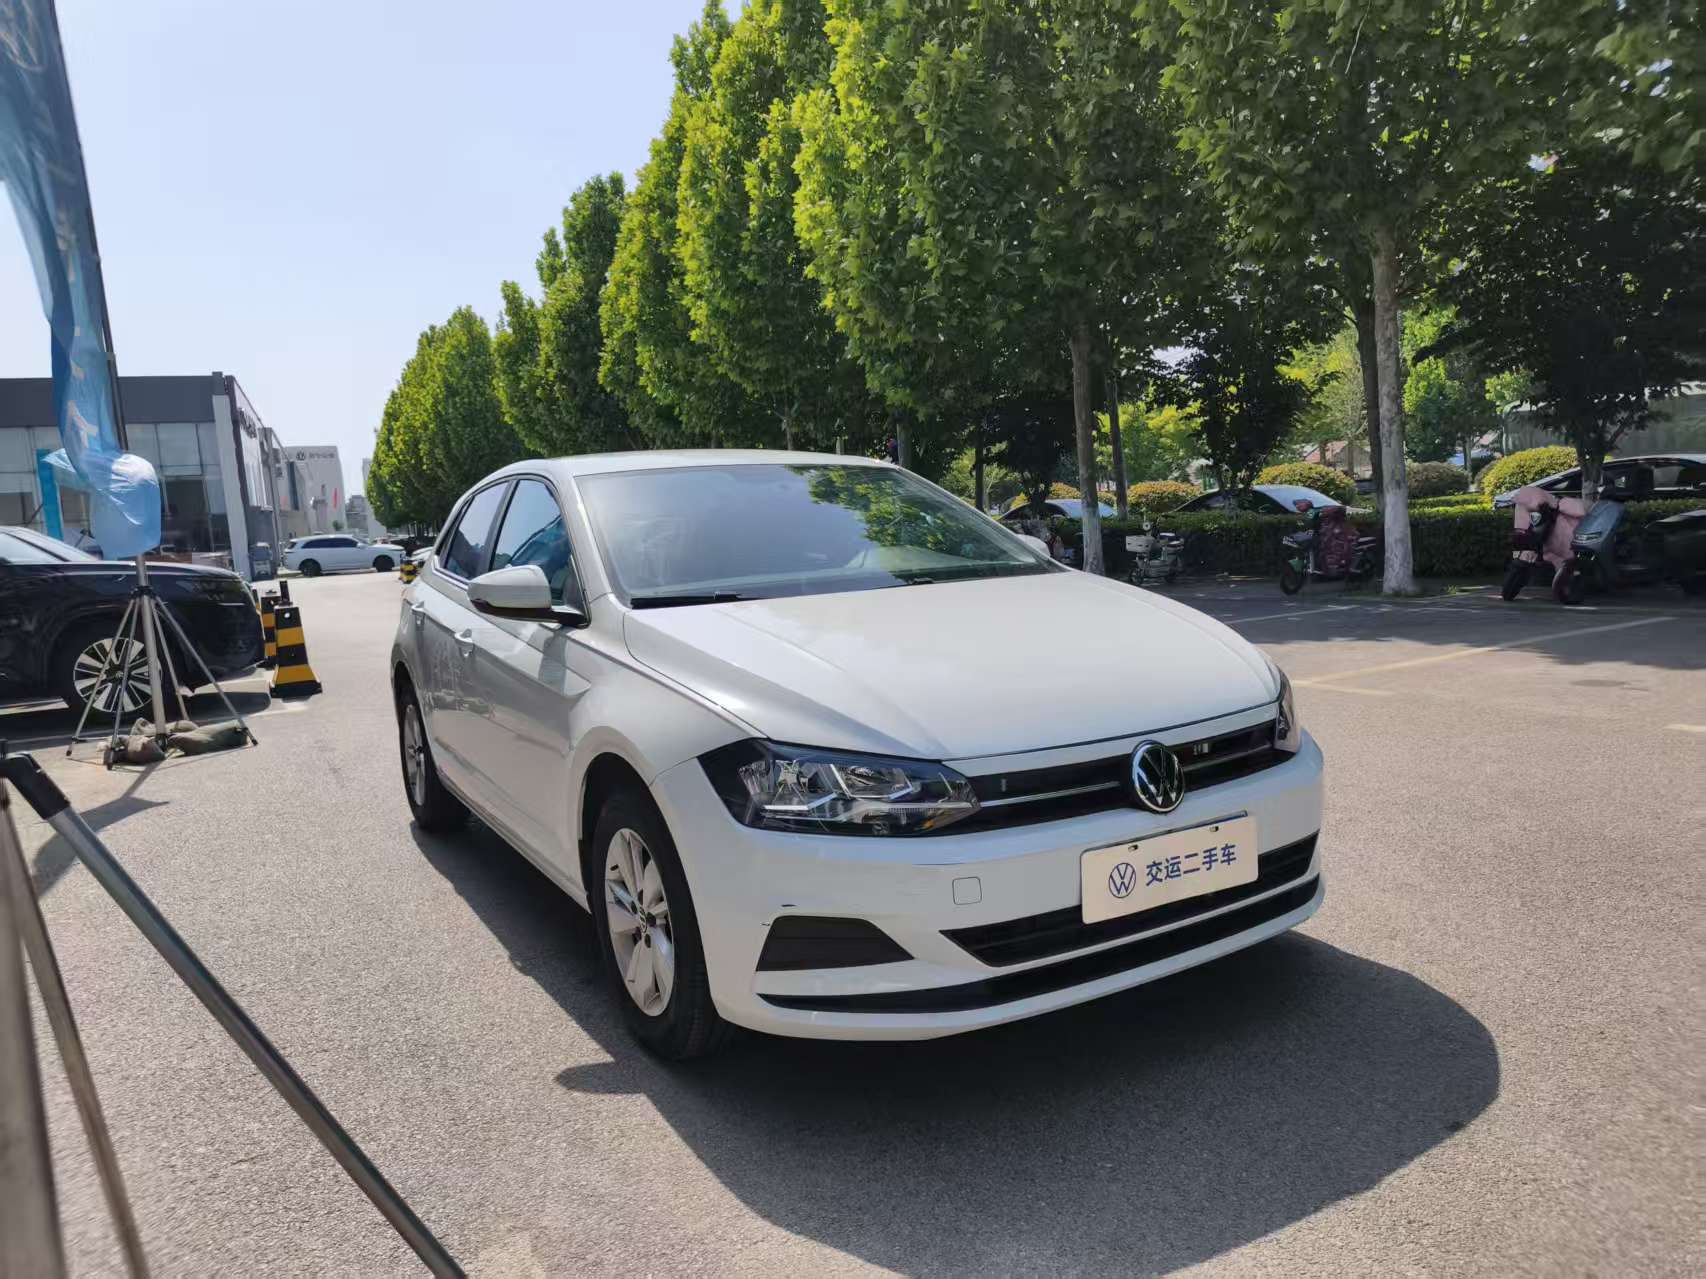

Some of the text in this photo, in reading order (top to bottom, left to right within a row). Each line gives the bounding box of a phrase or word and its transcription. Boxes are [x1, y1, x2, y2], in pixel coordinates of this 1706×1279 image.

[1145, 843, 1237, 887] 交运二手车
